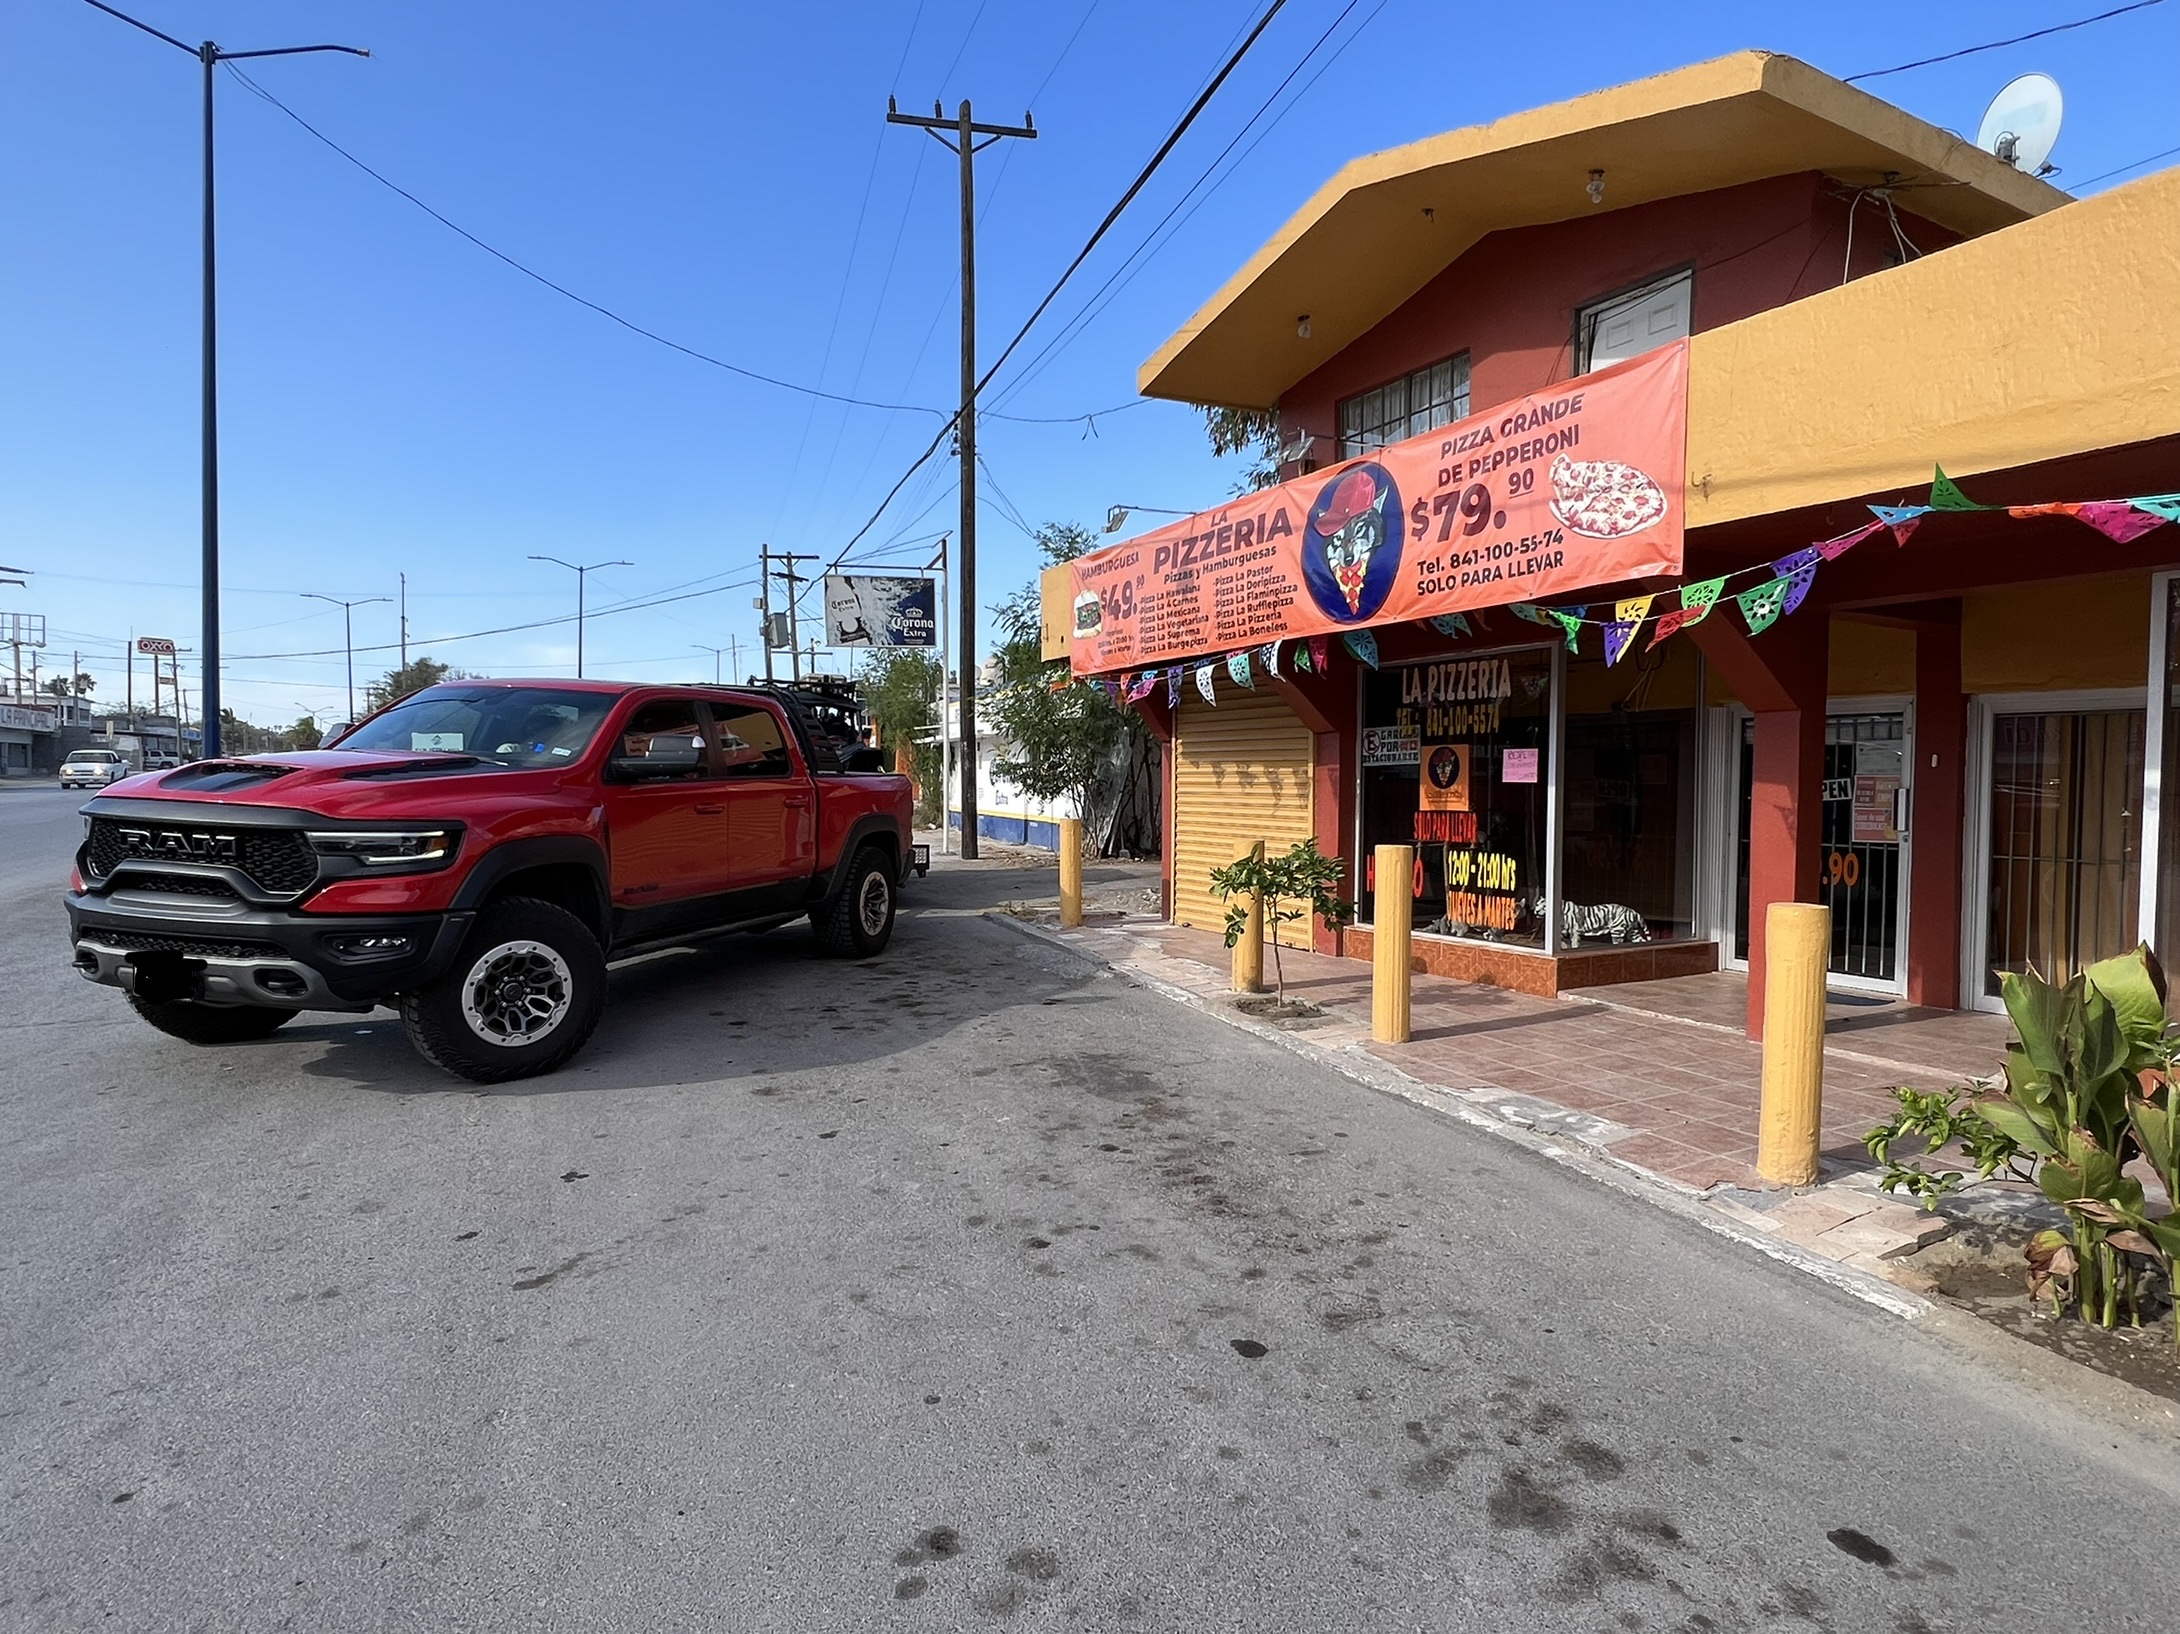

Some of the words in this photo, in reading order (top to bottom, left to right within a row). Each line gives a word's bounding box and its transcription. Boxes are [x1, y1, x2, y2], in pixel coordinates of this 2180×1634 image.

[1441, 426, 1495, 460] PIZZA
[1500, 393, 1585, 438] GRANDE
[1438, 464, 1462, 487] DE
[1469, 424, 1579, 479] PEPPERONI
[1210, 511, 1227, 528] LA
[1153, 507, 1293, 575] PIZZERIA
[1417, 556, 1445, 576] Tel.
[1450, 528, 1564, 570] 841-100-55-74
[1164, 568, 1193, 584] Pizzas
[1196, 569, 1201, 580] y
[1202, 546, 1277, 575] Hamburguesas
[1235, 571, 1244, 582] La
[1247, 565, 1273, 579] Pastor
[1417, 575, 1456, 596] SOLO
[1461, 565, 1503, 587] PARA
[1508, 551, 1563, 578] LLEVAR
[1236, 583, 1244, 593] La
[1247, 574, 1286, 590] Doripizza
[1156, 590, 1164, 600] La
[1236, 593, 1244, 604] La
[1247, 584, 1298, 602] Flaminpizza
[831, 598, 856, 610] Corona
[1157, 601, 1164, 611] La
[1157, 612, 1165, 621] La
[1166, 605, 1200, 619] Mexicana
[1236, 604, 1245, 615] La
[1247, 596, 1294, 613] Rufflepizza
[891, 615, 934, 632] Corona
[1157, 622, 1165, 631] La
[1237, 616, 1246, 626] La
[1248, 610, 1282, 625] Pizzeria
[903, 628, 927, 638] Extra
[1158, 632, 1165, 641] La
[1167, 628, 1200, 641] Suprema
[1238, 627, 1247, 638] La
[1250, 622, 1288, 636] Boneless
[141, 640, 173, 652] OXXO
[1158, 642, 1166, 651] La
[1168, 637, 1208, 651] Burgepizza
[1402, 667, 1422, 704] LA
[1427, 659, 1512, 702] PIZZERIA
[1426, 704, 1499, 737] 841-100-5574
[1381, 741, 1398, 753] POR
[1363, 752, 1419, 763] ESTACIONARSE
[1822, 780, 1849, 799] PEN
[1414, 812, 1431, 841] SOLO
[1433, 812, 1450, 842] PARA
[1451, 812, 1478, 843] LLEVAR
[119, 828, 236, 857] RAM
[1448, 850, 1470, 887] 12:00
[1477, 852, 1500, 890] 21:00
[1502, 854, 1517, 892] hrs
[1448, 890, 1476, 925] JUEVES
[1477, 894, 1483, 926] A
[1484, 896, 1516, 931] MARTES
